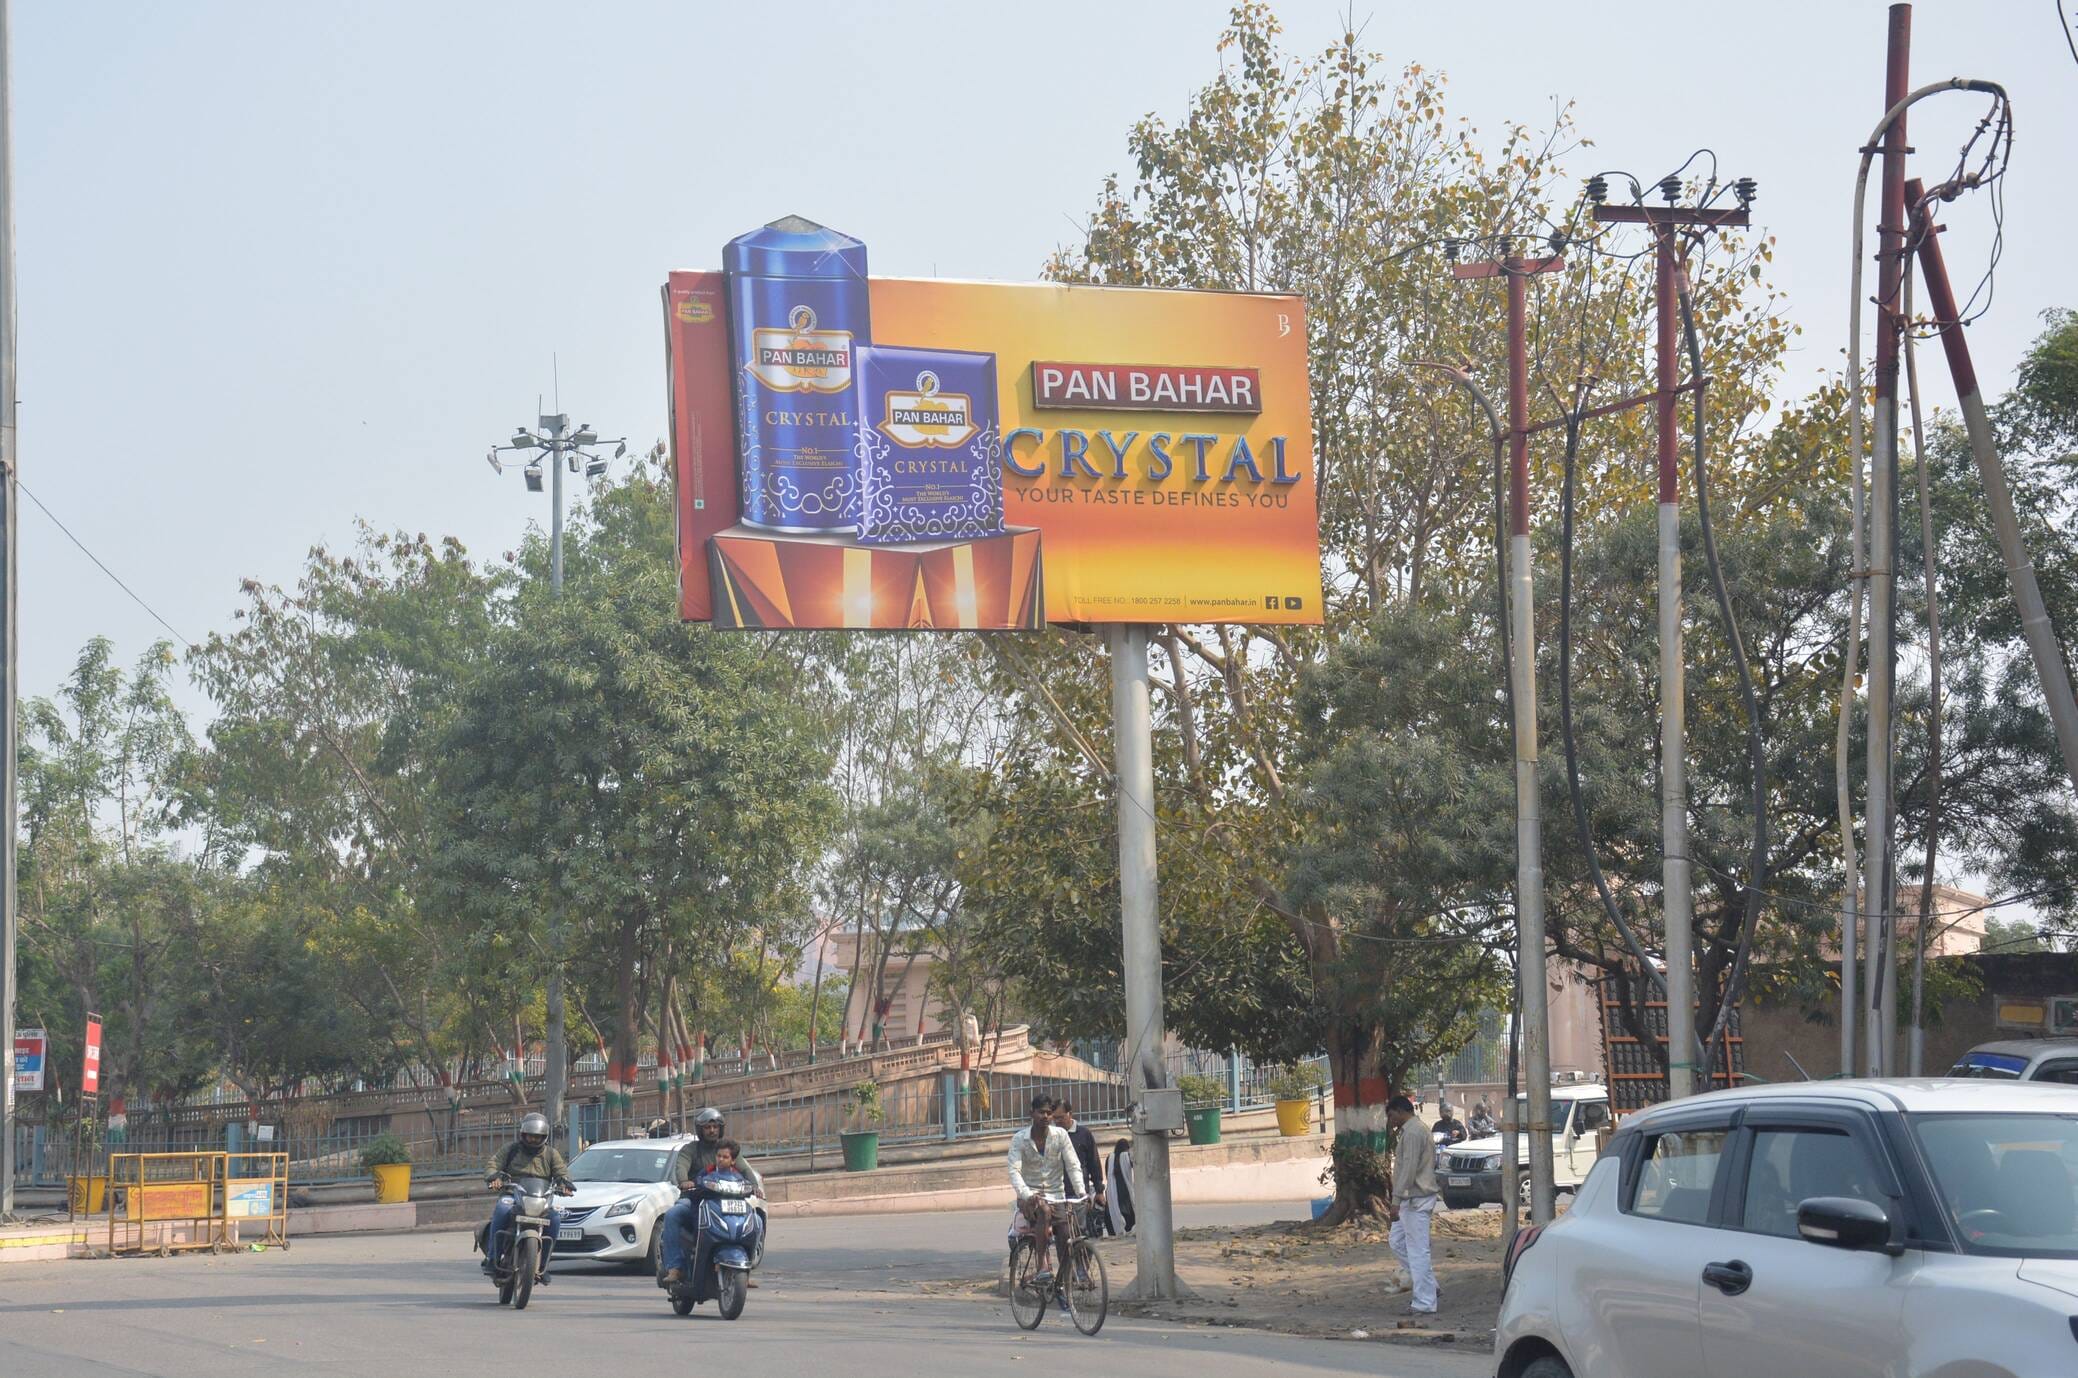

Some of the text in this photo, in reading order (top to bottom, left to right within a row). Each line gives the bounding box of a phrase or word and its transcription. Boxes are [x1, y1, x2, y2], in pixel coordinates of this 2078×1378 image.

[763, 350, 846, 366] PAN BAHAR
[1042, 368, 1252, 405] PAN BAHAR
[765, 411, 851, 426] CRYSTAL
[894, 411, 963, 424] PAN BAHAR
[1002, 426, 1302, 484] CRYSTAL
[894, 460, 968, 473] CRYSTAL
[1016, 487, 1288, 509] YOUR TASTE DEFINES YOU
[1190, 597, 1257, 607] www.panbahar.in
